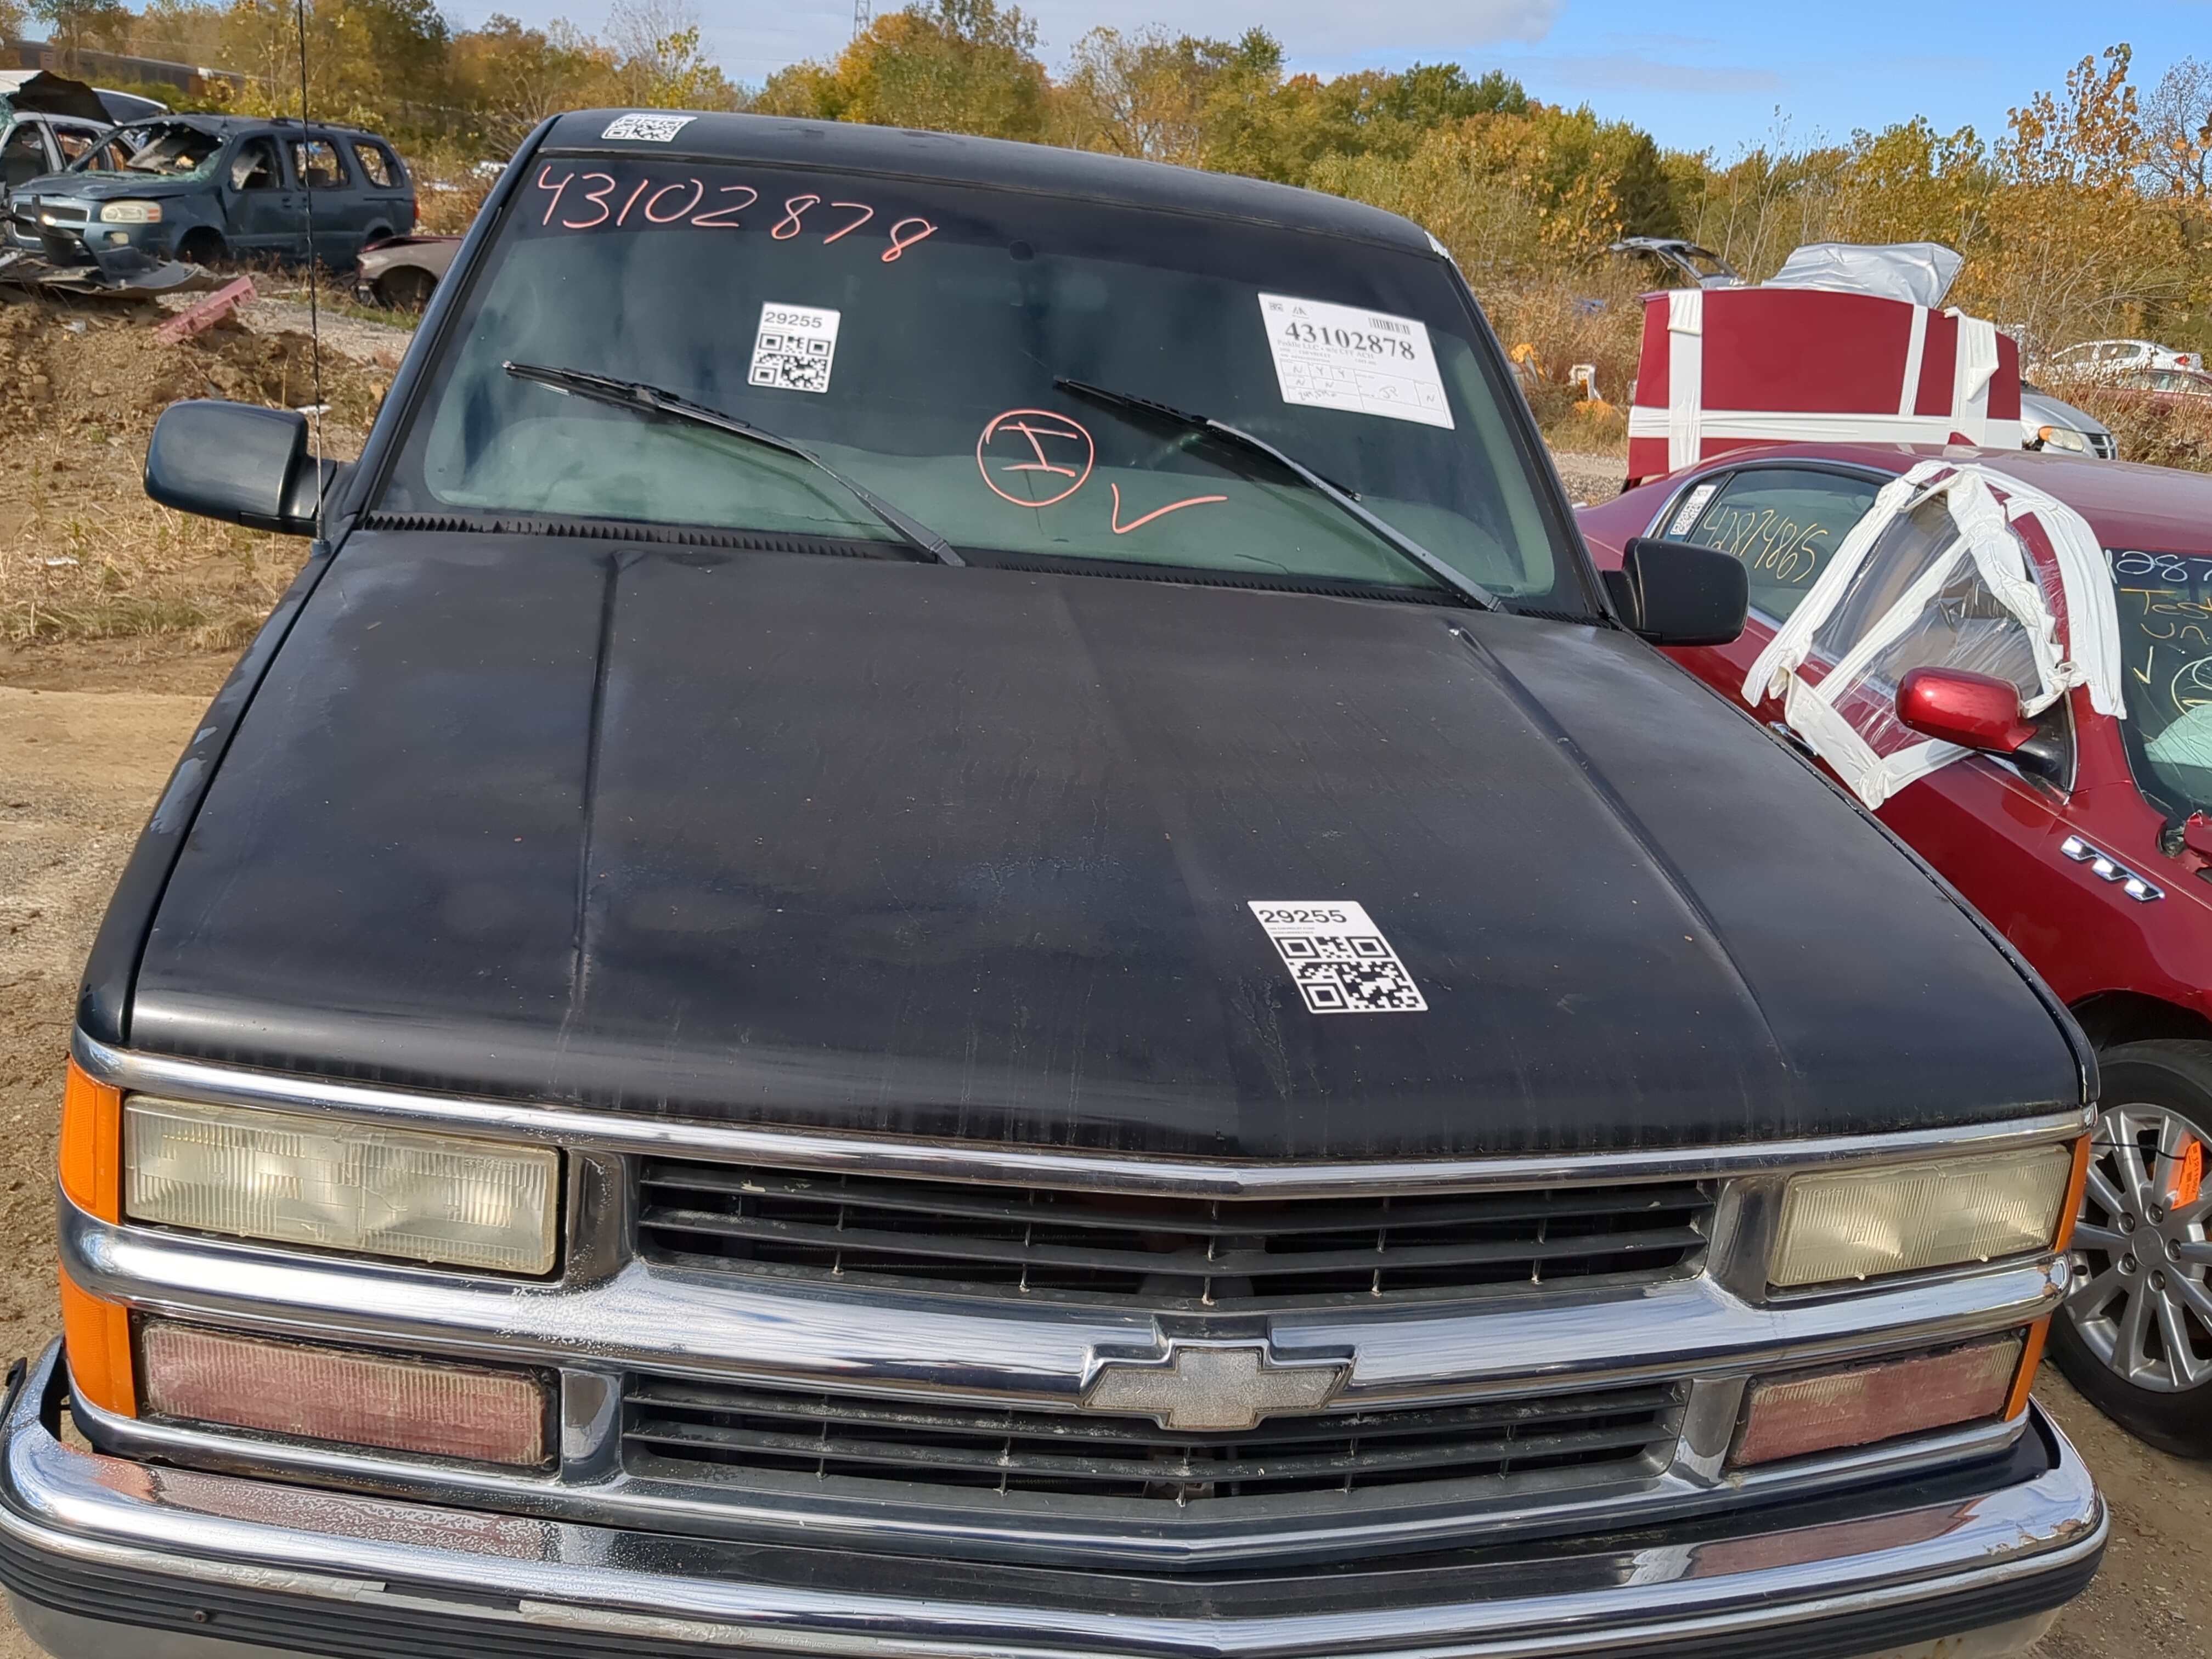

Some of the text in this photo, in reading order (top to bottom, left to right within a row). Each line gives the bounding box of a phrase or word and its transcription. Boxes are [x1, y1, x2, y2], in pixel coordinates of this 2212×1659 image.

[764, 312, 822, 328] 29255
[1277, 340, 1301, 348] Peddle
[1285, 322, 1415, 360] 43102878
[1259, 910, 1347, 923] 29255
